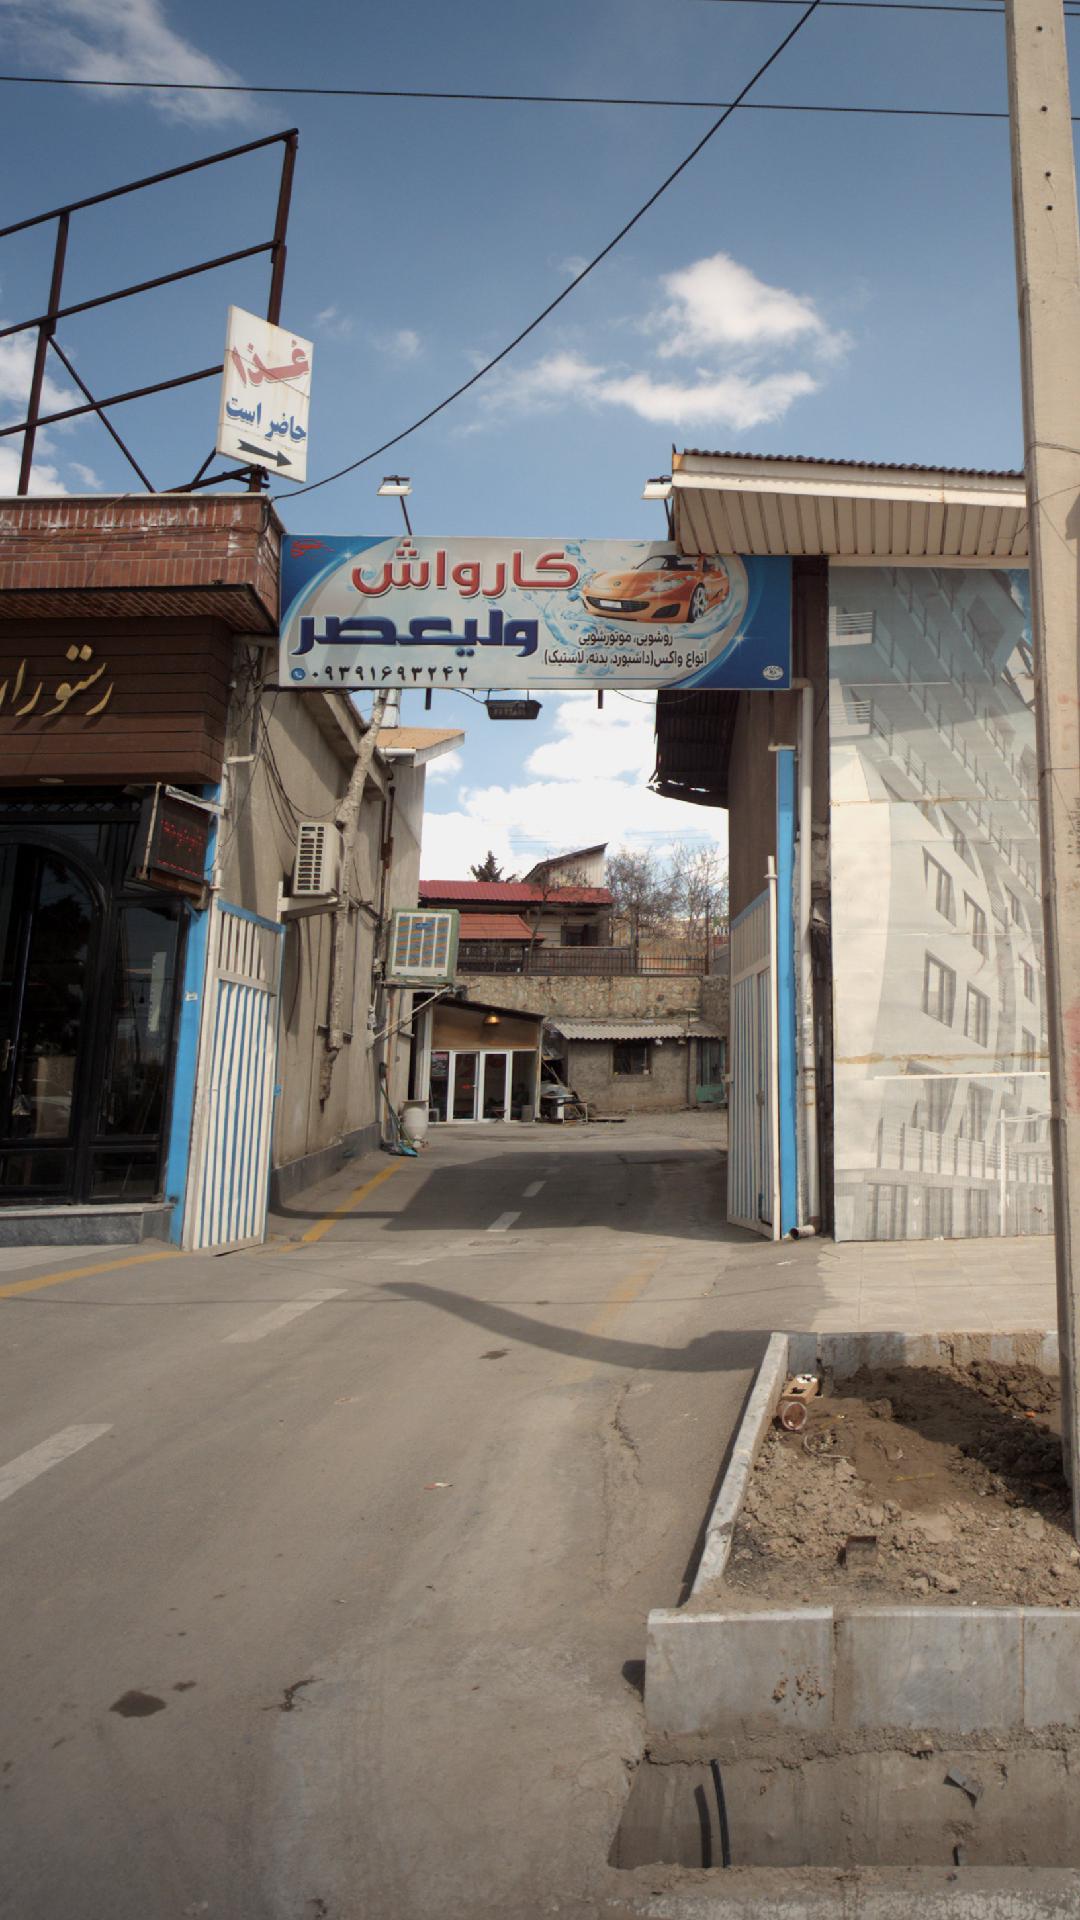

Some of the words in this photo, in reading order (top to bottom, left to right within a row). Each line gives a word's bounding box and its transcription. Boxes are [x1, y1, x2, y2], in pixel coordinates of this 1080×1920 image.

[231, 339, 309, 386] غذا
[226, 397, 262, 427] است
[265, 412, 306, 442] حاضر
[351, 539, 579, 597] کارواش
[291, 608, 539, 657] ولیعصر
[0, 644, 114, 717] رستورا
[686, 650, 707, 668] انواع
